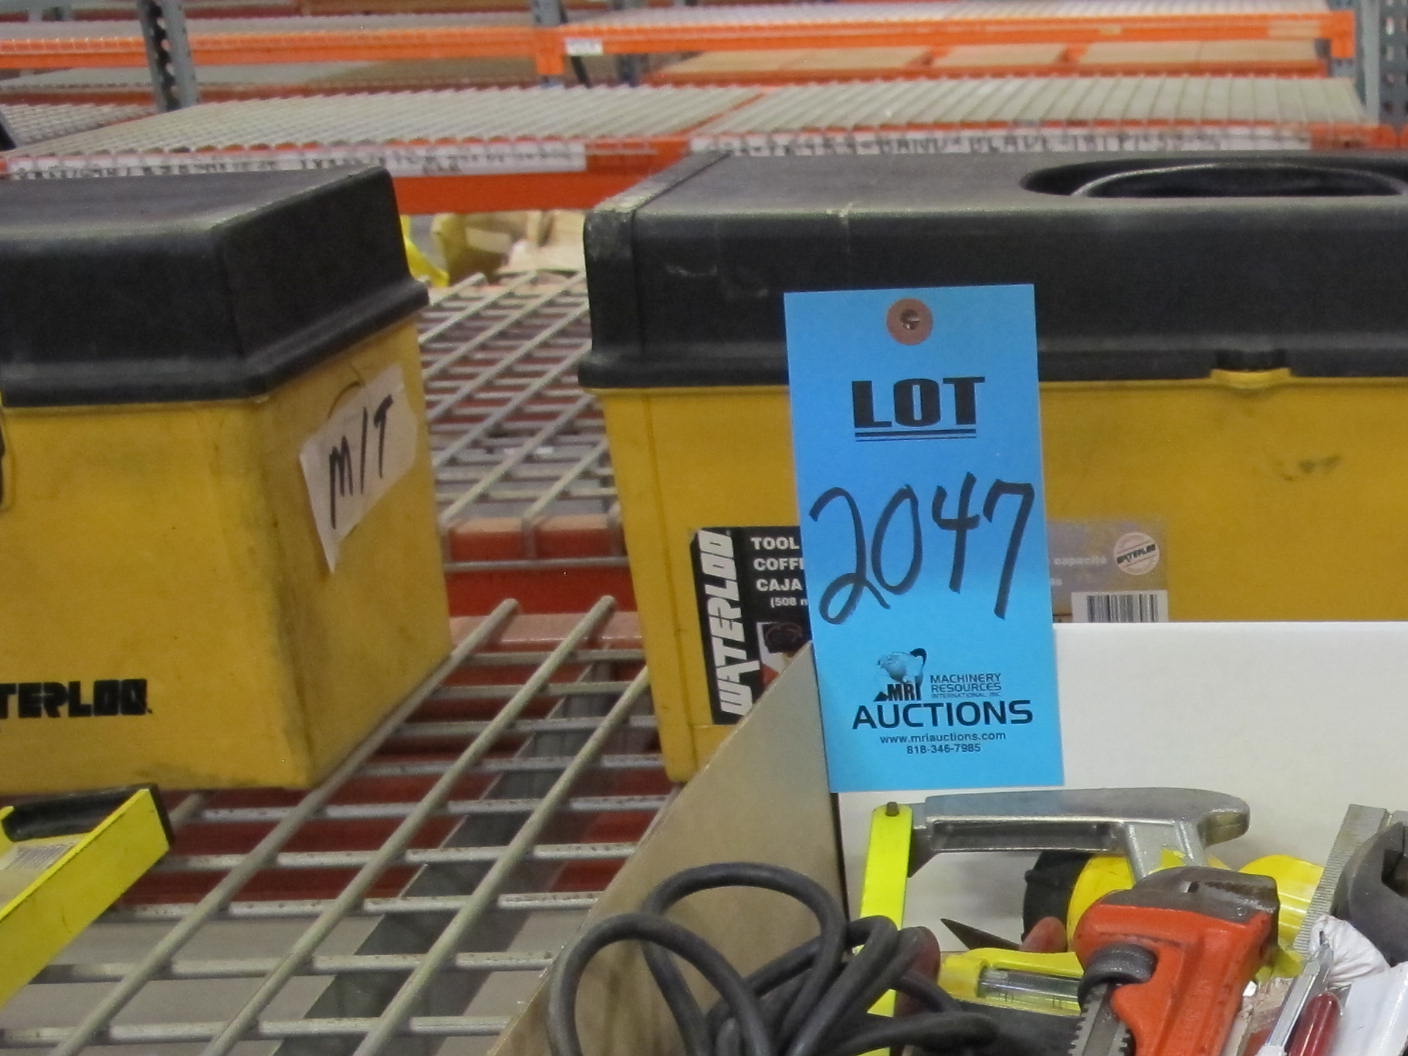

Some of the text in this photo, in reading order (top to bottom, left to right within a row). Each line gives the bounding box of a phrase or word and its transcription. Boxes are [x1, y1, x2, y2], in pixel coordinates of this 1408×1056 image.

[851, 376, 985, 430] LOT
[751, 536, 800, 551] TOOL
[809, 472, 1036, 626] 2047
[753, 558, 805, 571] COFF
[756, 578, 803, 592] CAJA
[930, 673, 1001, 684] MACHINERY
[886, 683, 922, 701] MRI
[931, 682, 1002, 693] RESOURCES
[852, 700, 1033, 730] AUCTIONS
[879, 732, 1007, 744] www.mriauctions.com
[906, 743, 982, 755] 818-346-7985
